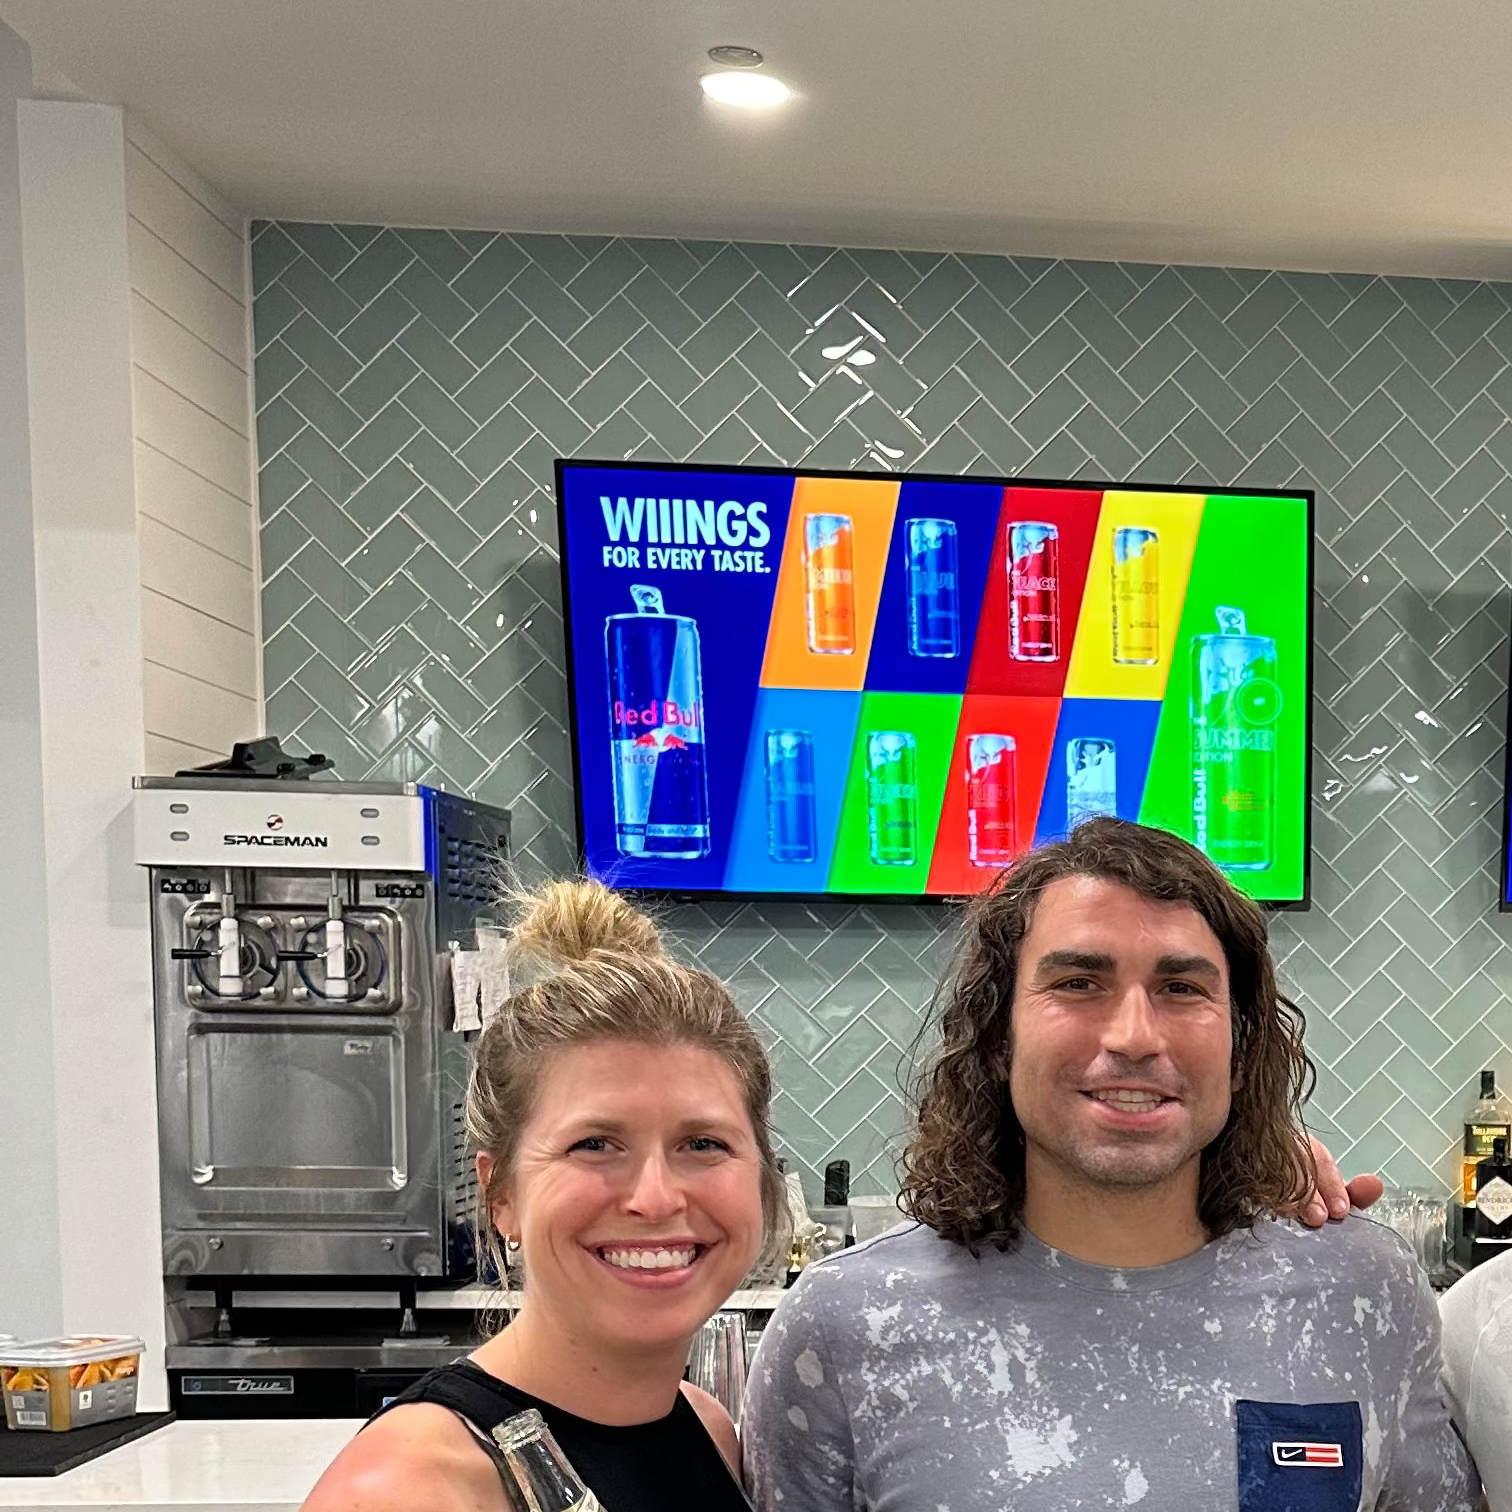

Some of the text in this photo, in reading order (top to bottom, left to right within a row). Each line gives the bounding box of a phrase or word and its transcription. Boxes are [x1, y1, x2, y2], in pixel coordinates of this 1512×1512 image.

[599, 496, 771, 548] WIIINGS
[602, 546, 772, 574] FOR EVERY TASTE.
[663, 702, 700, 726] Bul
[223, 834, 328, 848] SPACEMAN
